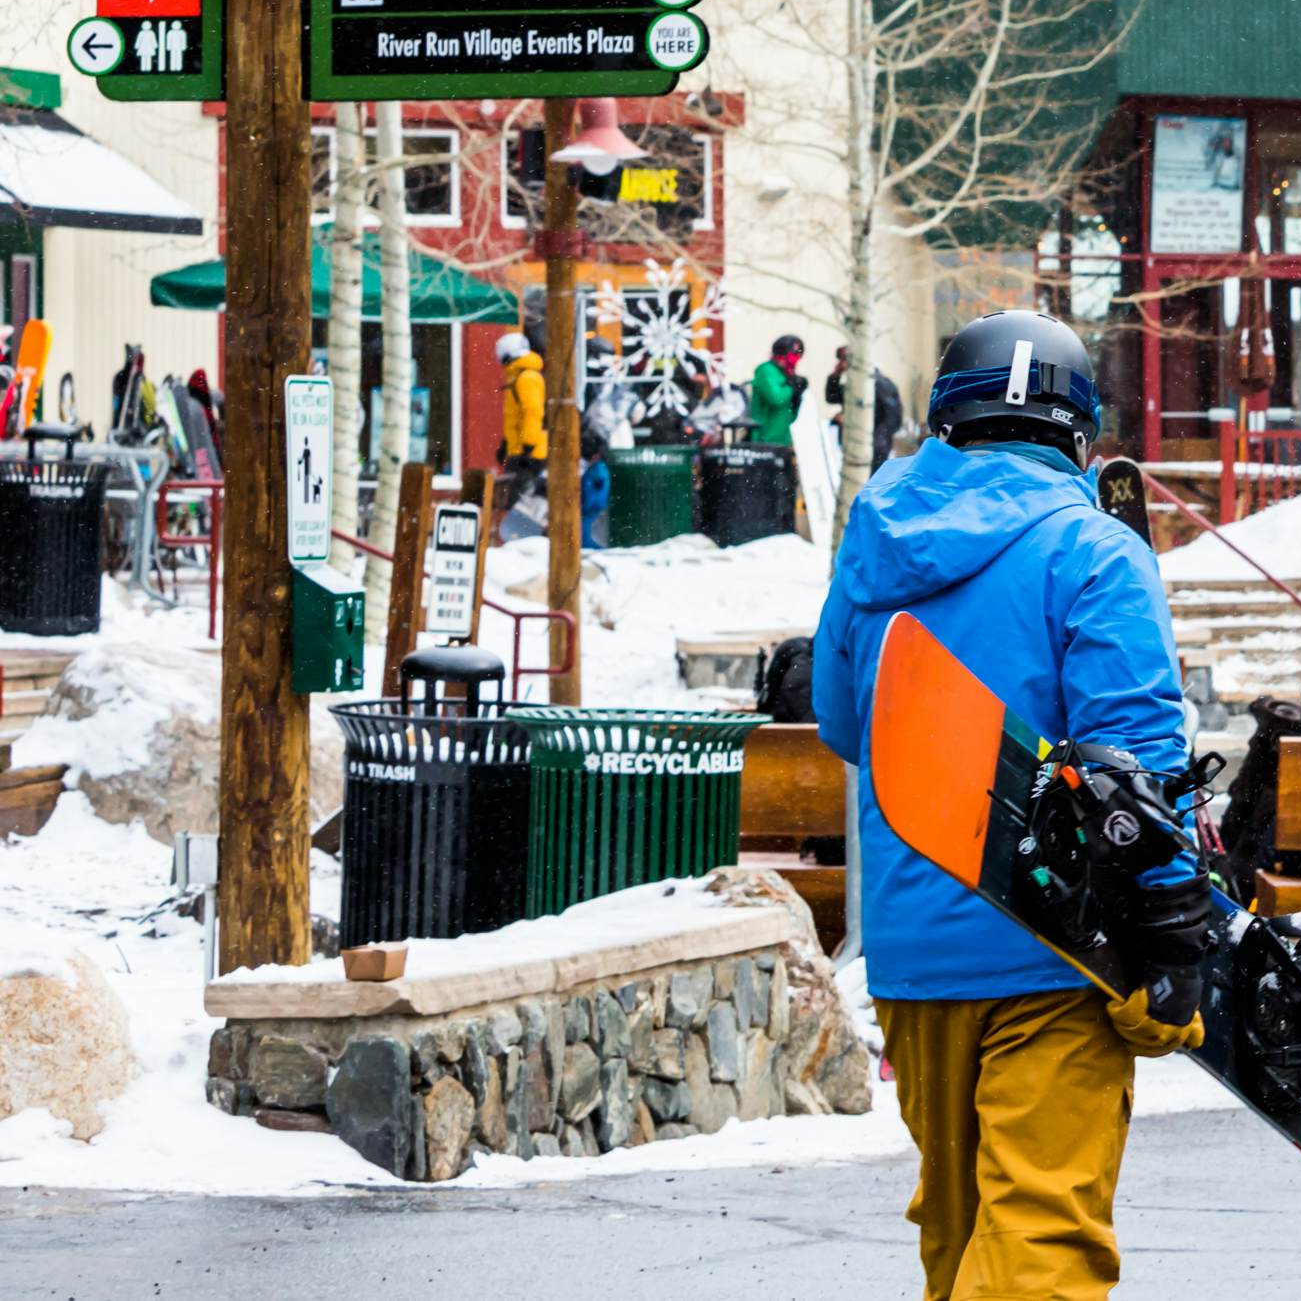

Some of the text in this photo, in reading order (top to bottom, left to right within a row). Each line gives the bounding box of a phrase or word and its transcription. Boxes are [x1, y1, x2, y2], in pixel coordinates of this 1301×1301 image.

[656, 27, 692, 38] YOU ARE
[378, 26, 634, 61] River Run Village Events Plaza
[655, 40, 695, 54] HERE
[367, 762, 416, 782] TRASH
[602, 749, 744, 775] RECYCLABLES
